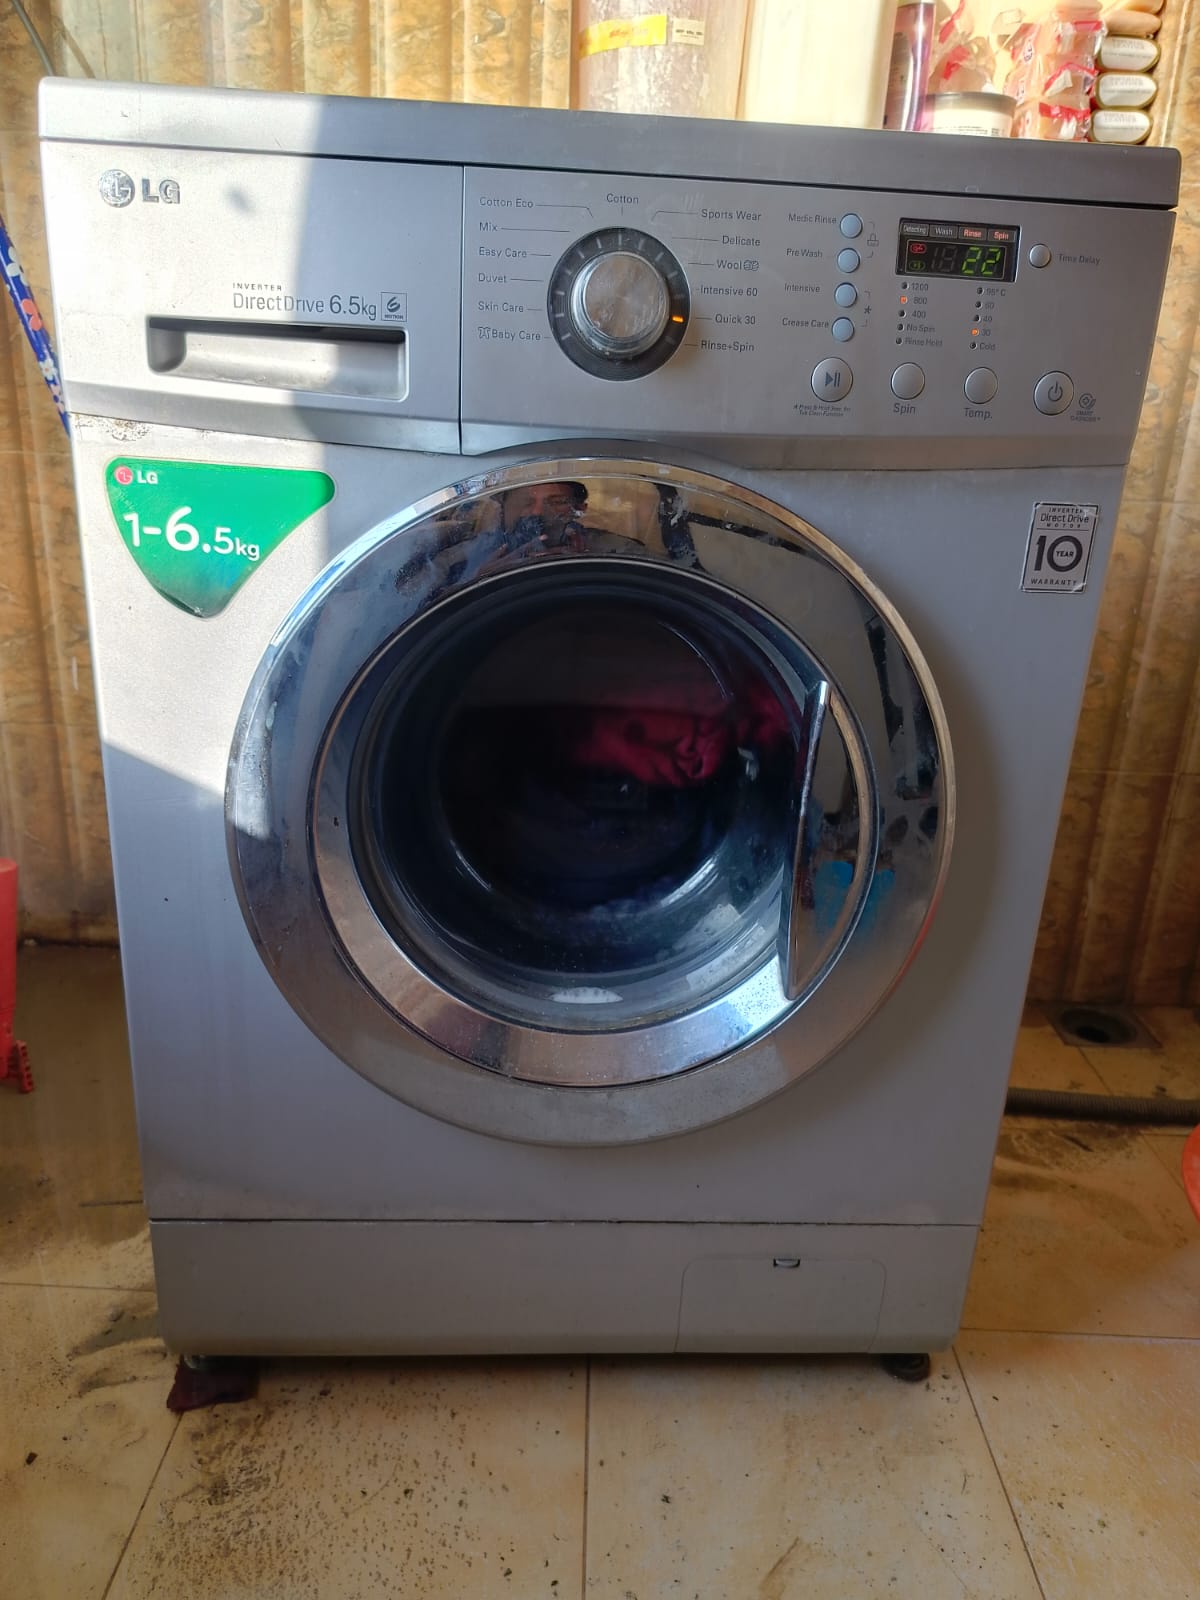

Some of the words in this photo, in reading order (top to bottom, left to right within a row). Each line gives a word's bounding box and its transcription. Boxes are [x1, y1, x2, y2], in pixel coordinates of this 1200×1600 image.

[141, 178, 181, 204] LG
[479, 196, 512, 207] Cotton
[515, 198, 534, 208] Eco
[606, 192, 639, 204] Cotton
[701, 208, 733, 220] Sports
[736, 210, 762, 220] Wear
[788, 213, 813, 222] Medic
[814, 215, 837, 224] Rinse
[479, 222, 498, 232] Mix
[935, 227, 953, 236] Wash
[964, 229, 982, 238] Rinse
[994, 231, 1009, 240] Spin
[722, 235, 760, 246] Delicate
[479, 246, 502, 260] Easy
[505, 248, 528, 258] Care
[786, 248, 800, 257] Pre
[801, 249, 823, 258] Wash
[716, 260, 742, 270] Wool
[961, 247, 1001, 275] 22
[478, 272, 506, 283] Duvet
[232, 282, 282, 291] INVERTER
[700, 284, 744, 296] Intensive
[746, 288, 758, 297] 60
[784, 283, 820, 293] Intensive
[911, 282, 928, 291] 1200
[329, 294, 377, 321] 6.5kg
[478, 301, 499, 311] Skin
[502, 302, 524, 313] Care
[715, 314, 742, 324] Quick
[744, 315, 756, 325] 30
[911, 310, 926, 318] 400
[782, 318, 809, 327] Crease
[811, 319, 829, 328] Care
[492, 329, 516, 341] Baby
[519, 330, 541, 340] Care
[701, 340, 755, 352] Rinse+Spin
[980, 342, 996, 351] Cold
[893, 403, 916, 418] Spin
[964, 407, 993, 420] Temp.
[137, 470, 158, 484] LG
[1040, 513, 1066, 522] Direct
[1067, 514, 1089, 523] Drive
[124, 506, 260, 561] 1-6.5kg
[1034, 535, 1083, 572] 10
[1056, 550, 1074, 558] YEAR
[1031, 578, 1077, 586] WARRANTY
